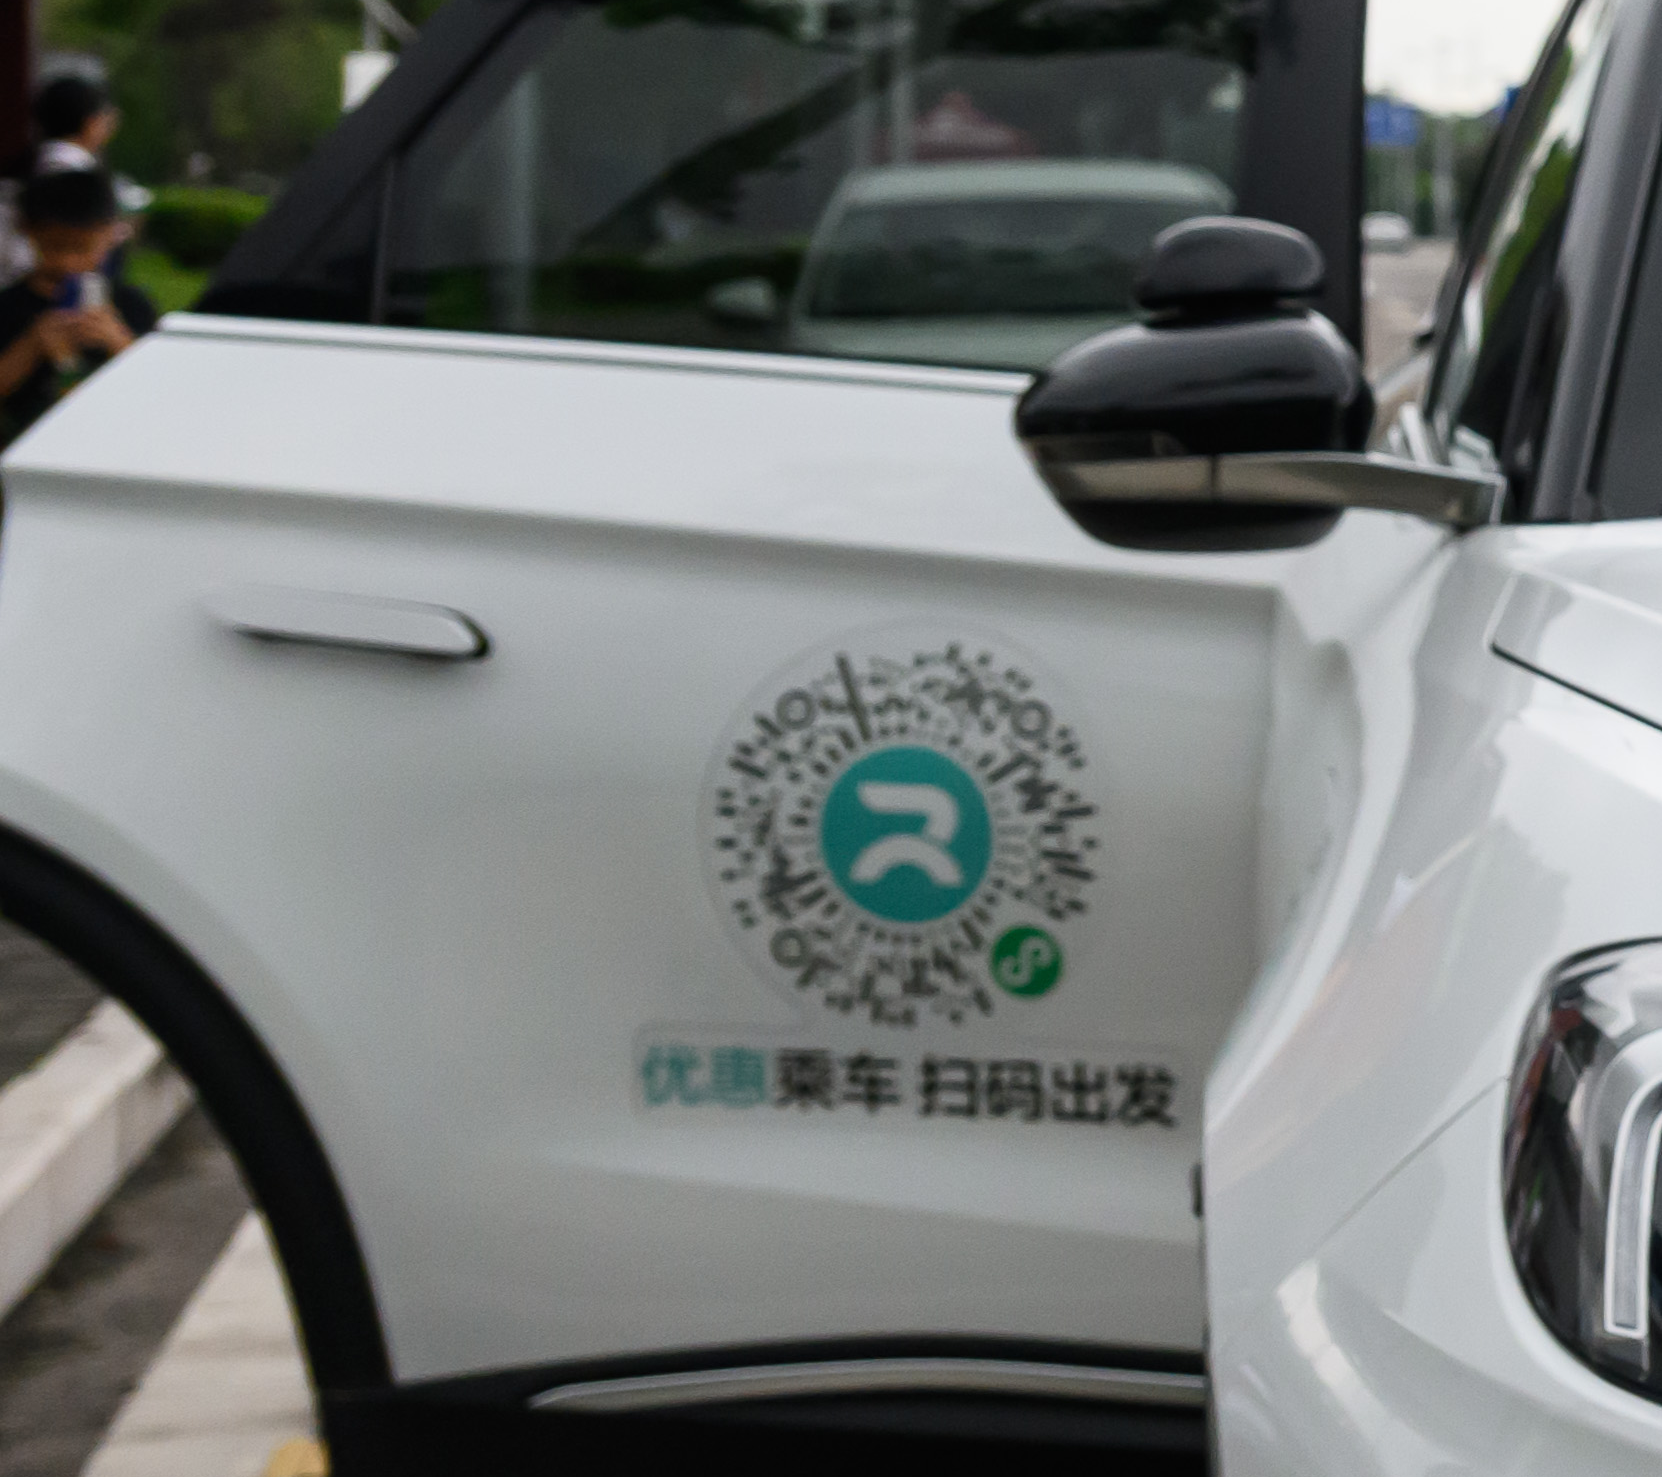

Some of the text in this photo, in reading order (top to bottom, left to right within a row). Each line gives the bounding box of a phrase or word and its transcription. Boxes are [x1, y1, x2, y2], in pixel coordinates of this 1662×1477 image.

[641, 1045, 1176, 1128] 优惠乘车 扫码出发
